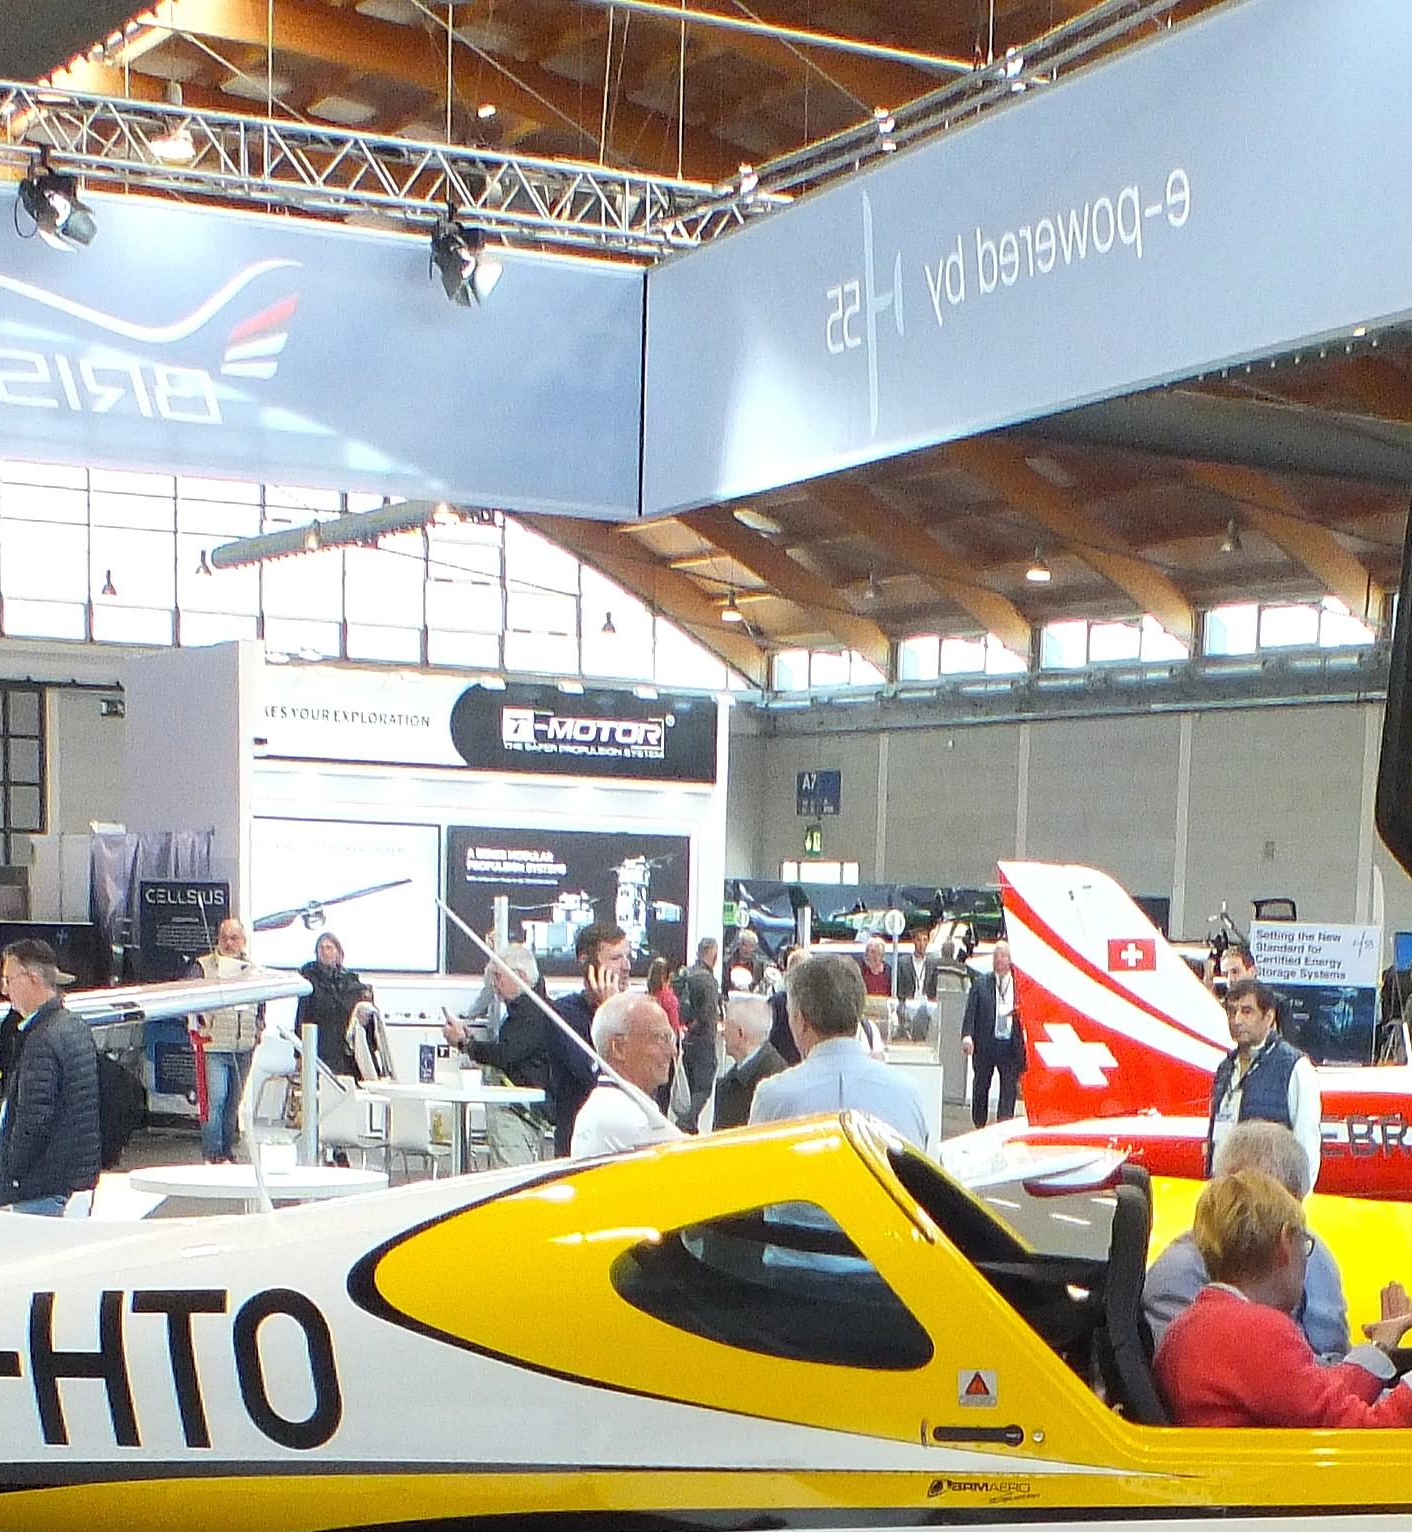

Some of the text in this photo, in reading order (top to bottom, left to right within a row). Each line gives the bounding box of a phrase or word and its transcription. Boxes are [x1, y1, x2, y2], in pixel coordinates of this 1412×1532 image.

[292, 707, 330, 722] YOUR
[502, 708, 664, 745] T-MOTOR
[802, 773, 817, 791] A7
[145, 888, 225, 905] CELLSIUS
[1256, 929, 1342, 942] Setting the New
[1256, 942, 1323, 954] Standard for
[1255, 954, 1342, 969] Certified Energy
[1299, 968, 1346, 980] Systems
